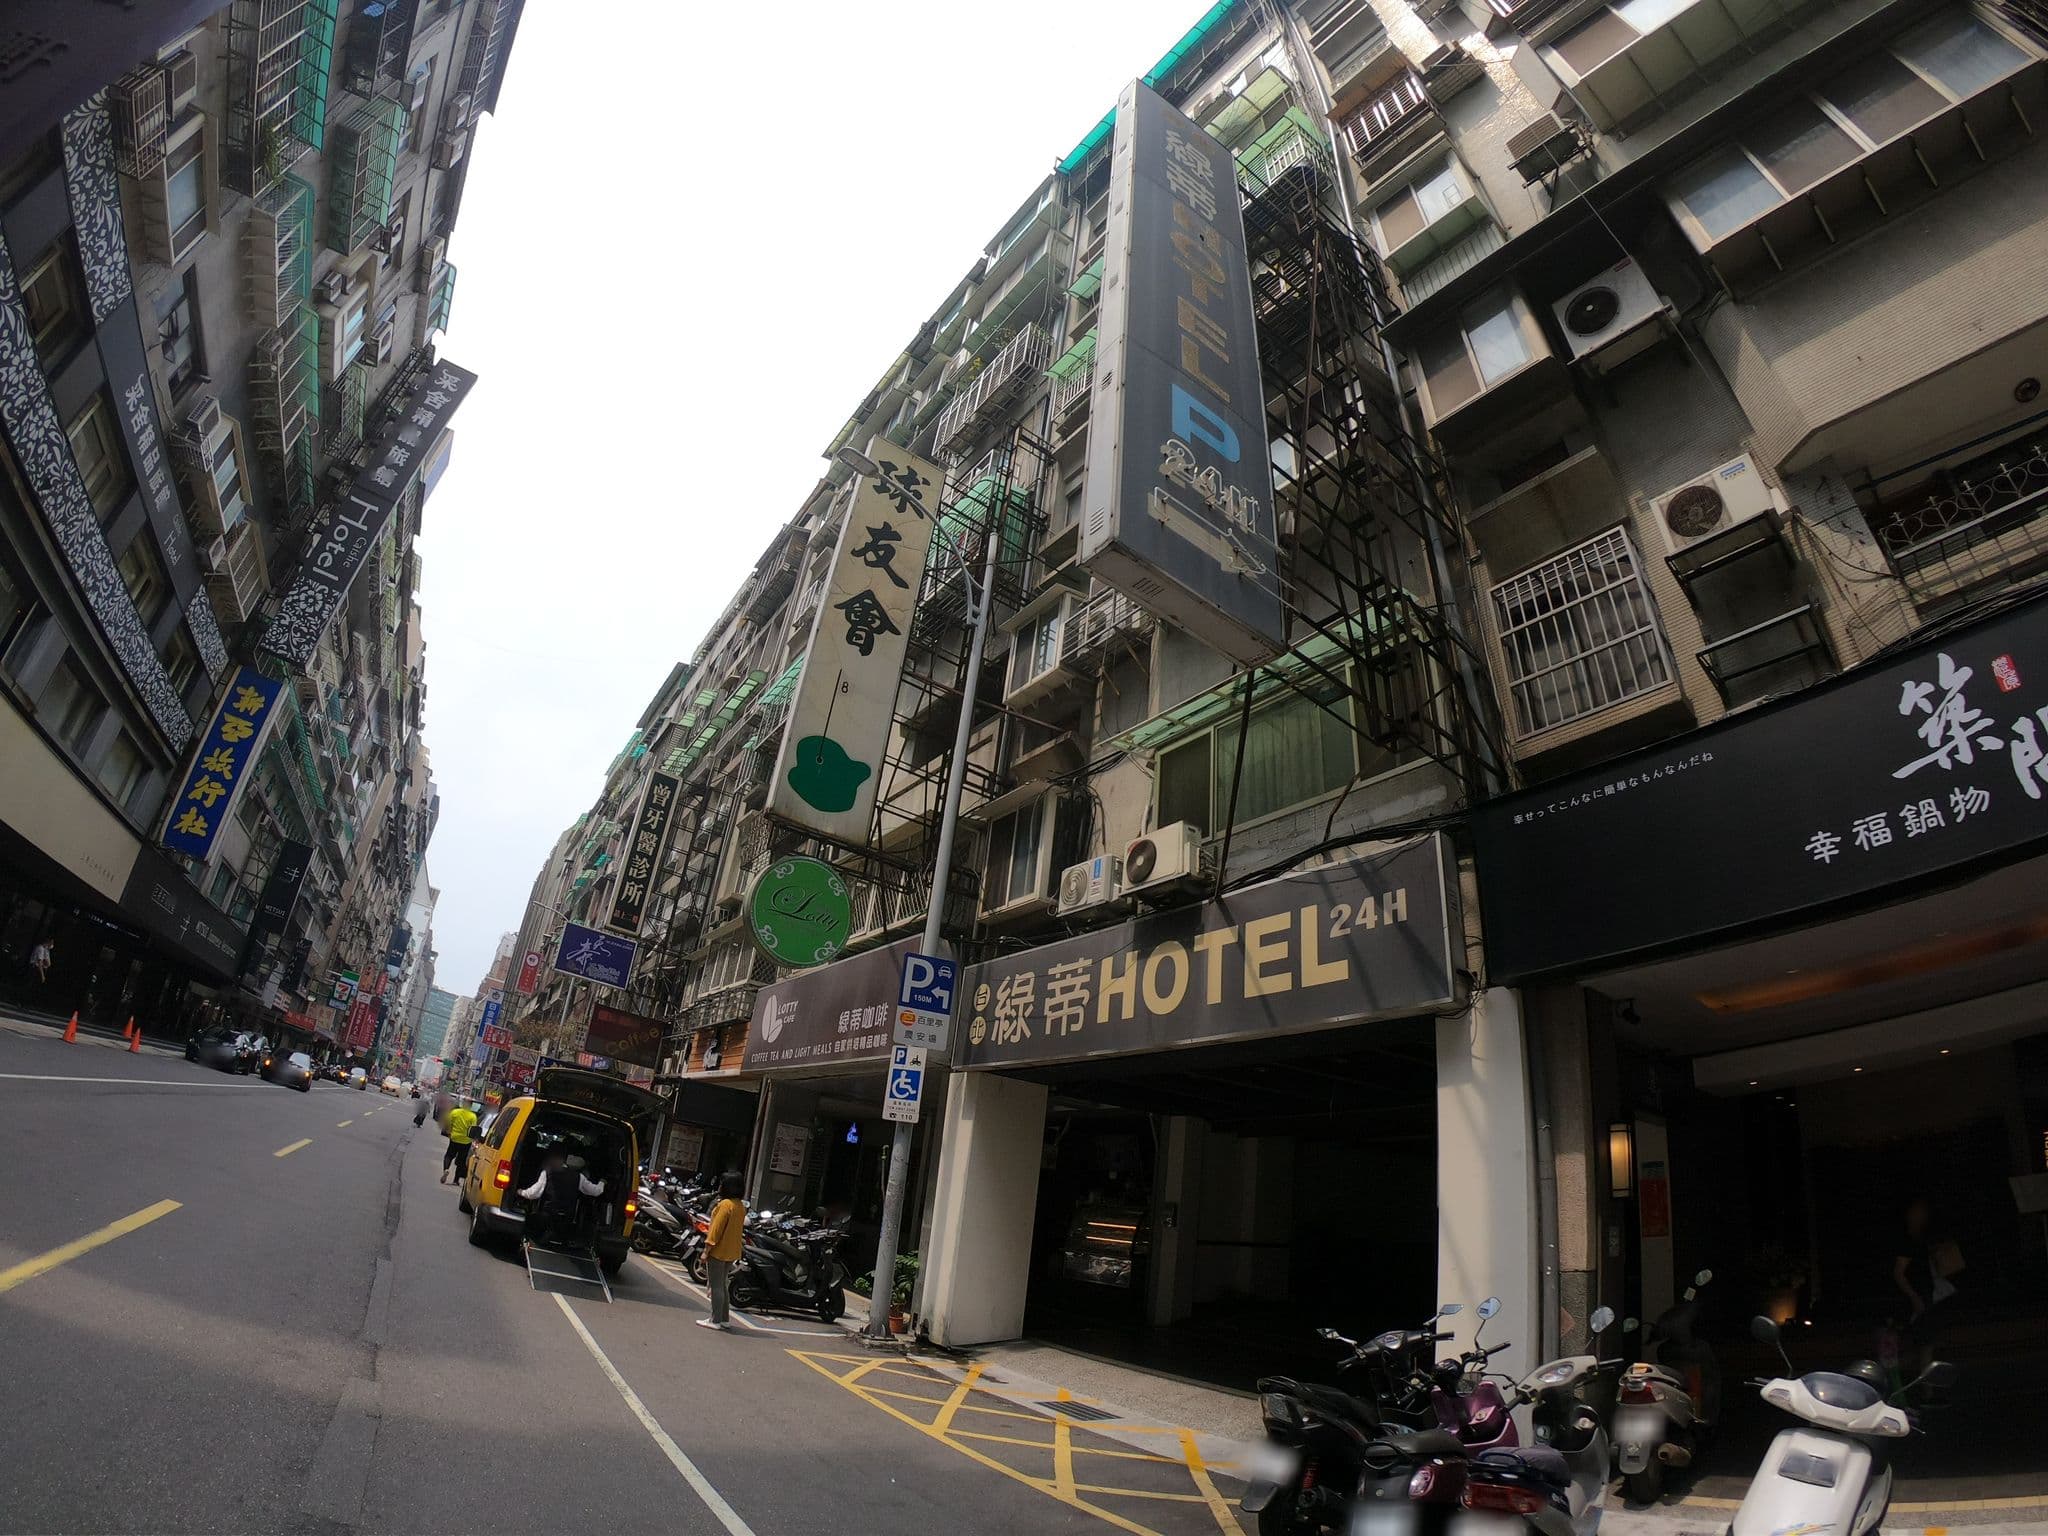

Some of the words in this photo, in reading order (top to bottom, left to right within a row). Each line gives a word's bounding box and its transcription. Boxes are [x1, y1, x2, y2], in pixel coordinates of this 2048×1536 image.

[1171, 383, 1240, 463] P
[312, 495, 379, 582] Hotel
[833, 459, 931, 657] 球友會
[841, 681, 849, 693] 8
[1513, 751, 1715, 825] 幸せってこんなに簡単なもんなんだね
[620, 782, 672, 907] 曾牙醫診所
[1804, 785, 1990, 864] 幸福鍋物
[1329, 887, 1407, 939] 24H
[901, 956, 935, 1004] P
[914, 994, 932, 1004] 150M
[991, 956, 1093, 1046] 綠蒂
[1096, 904, 1349, 1024] HOTEL
[777, 1000, 799, 1015] LOTTY
[837, 1002, 889, 1034] 綠蒂咖啡
[751, 1050, 768, 1063] COFFEE
[781, 1048, 793, 1060] AND
[794, 1045, 811, 1058] LIGHT
[812, 1042, 832, 1056] MEALS
[896, 1049, 905, 1062] P
